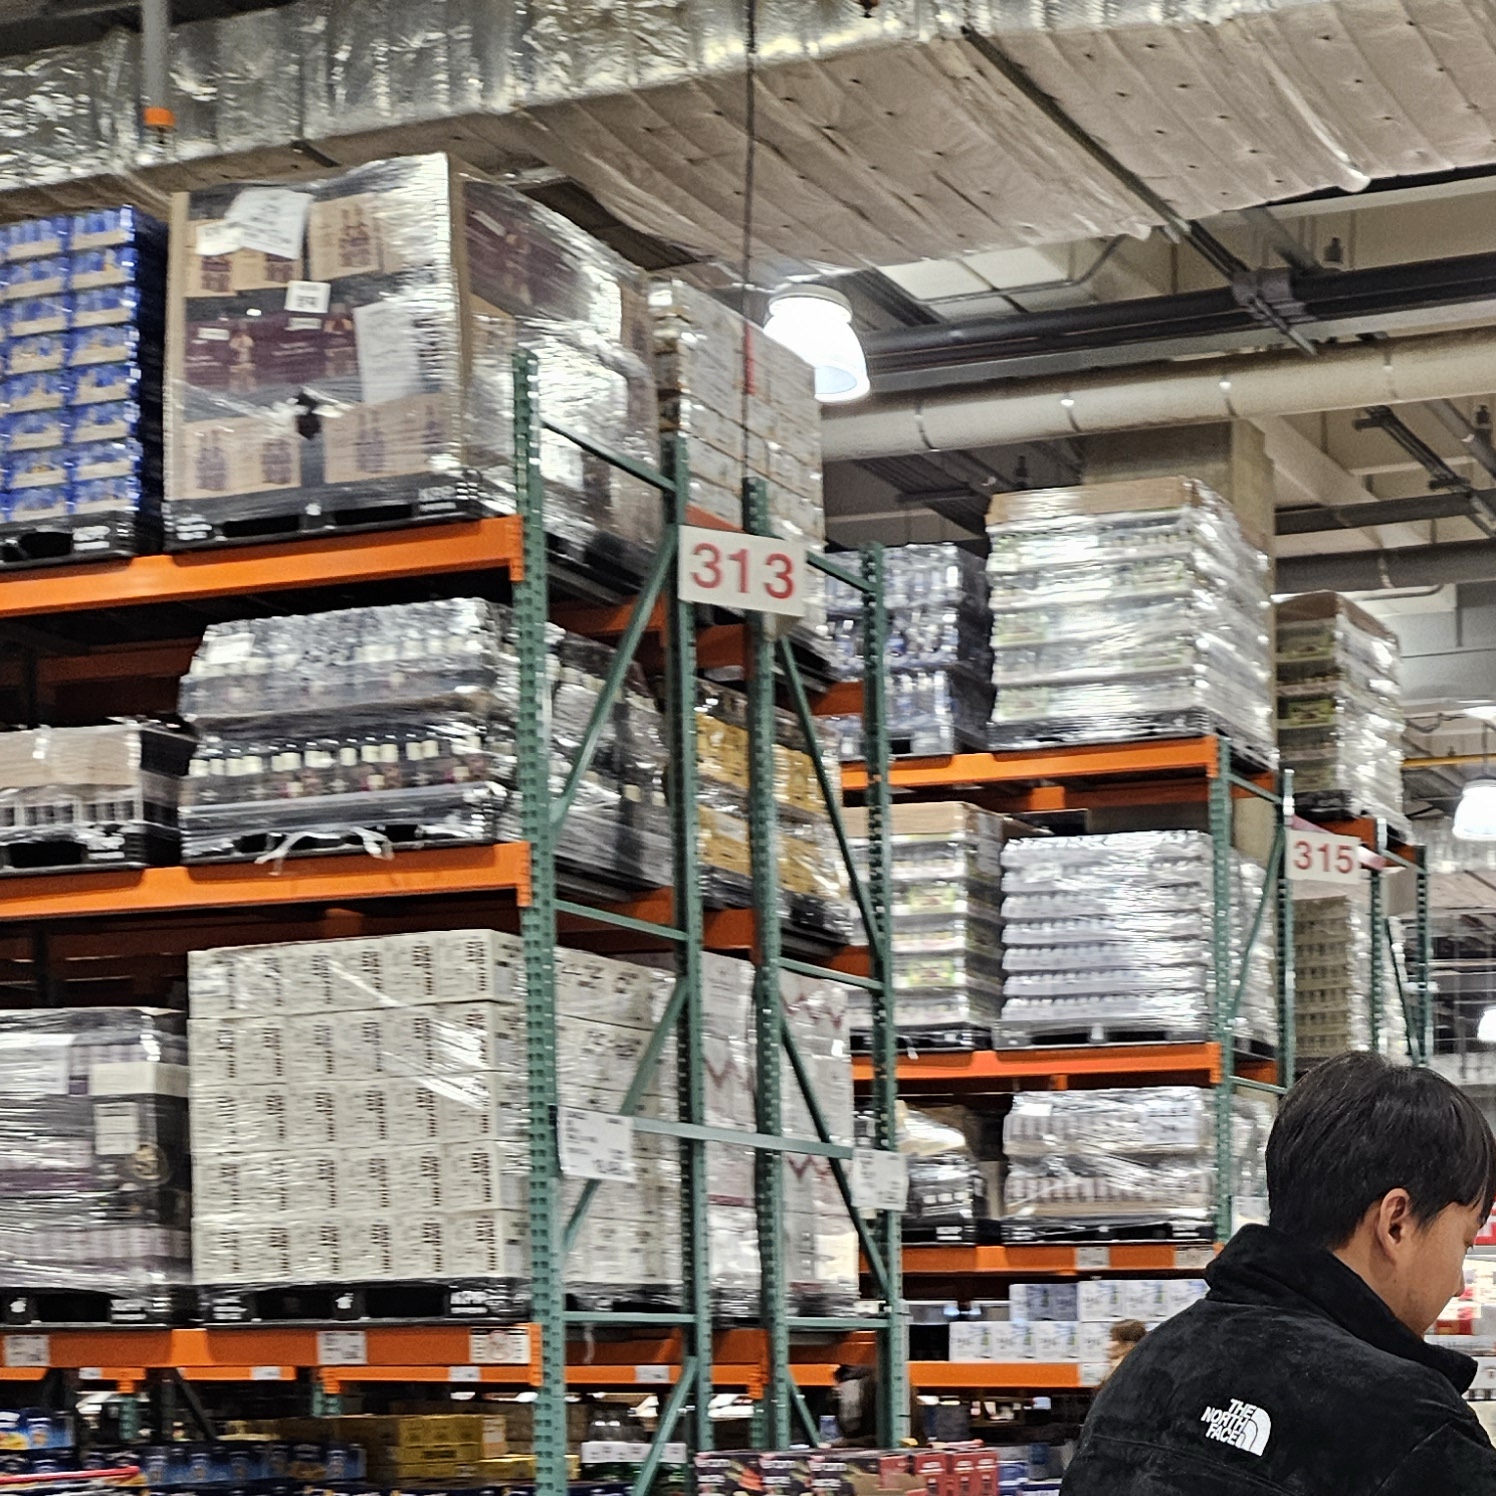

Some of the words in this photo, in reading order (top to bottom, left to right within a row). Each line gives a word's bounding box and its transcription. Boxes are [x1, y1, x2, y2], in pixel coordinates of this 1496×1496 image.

[690, 542, 794, 599] 313
[1293, 840, 1354, 874] 315
[1200, 1406, 1249, 1432] NORTH
[1228, 1398, 1258, 1419] THE
[1205, 1422, 1241, 1446] FACE
